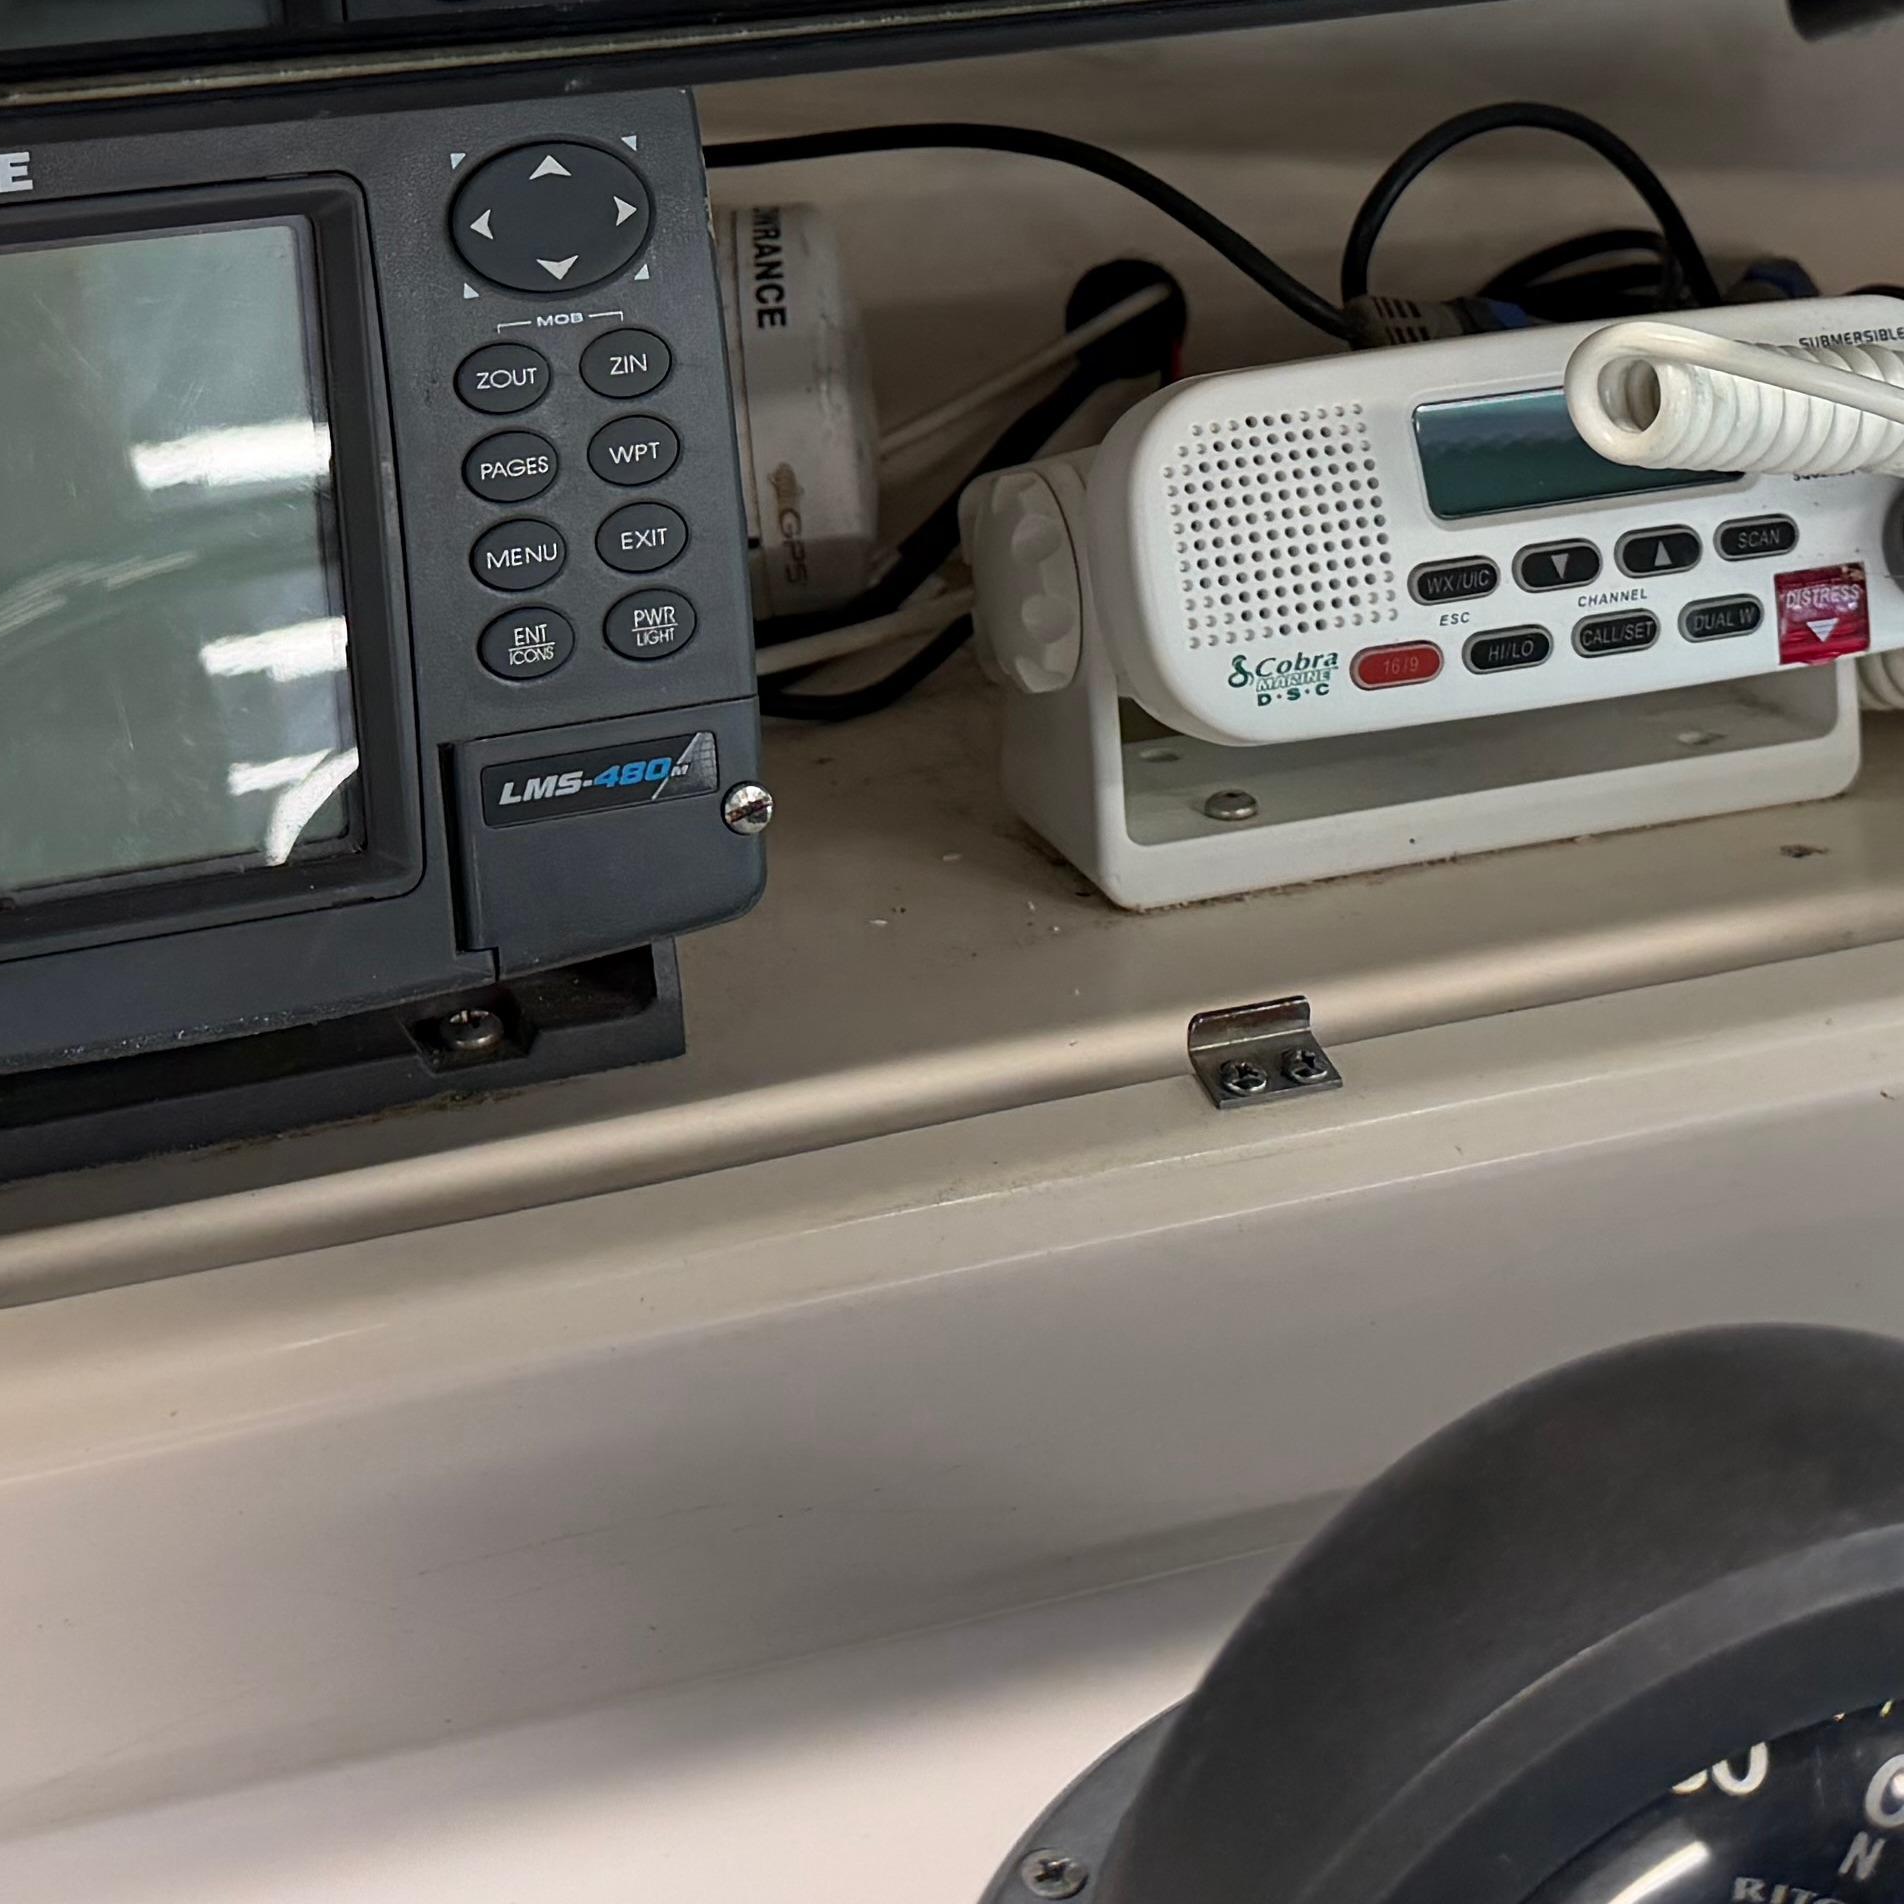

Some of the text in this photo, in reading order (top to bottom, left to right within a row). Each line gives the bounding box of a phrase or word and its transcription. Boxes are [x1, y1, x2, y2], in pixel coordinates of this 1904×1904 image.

[536, 312, 585, 327] MOB
[609, 353, 648, 376] ZIN
[476, 367, 537, 390] ZOUT
[609, 441, 661, 465] WPT
[480, 455, 549, 480] PAGES
[621, 527, 668, 550] EXIT
[1737, 528, 1780, 549] SCAN
[486, 543, 558, 570] MENU
[1578, 589, 1648, 607] CHANNEL
[1786, 584, 1861, 609] DISTRESS
[633, 606, 676, 628] PWR
[1439, 611, 1471, 627] ESC
[1696, 610, 1735, 632] DUAL
[514, 624, 547, 646] ENT
[636, 628, 675, 646] LIGHT
[1582, 620, 1654, 646] CALL/SET
[508, 647, 554, 665] ICONS
[1488, 639, 1535, 662] HI/LO
[1255, 652, 1339, 678] Cobra
[1383, 656, 1420, 676] 16/9
[1256, 669, 1333, 693] MARINE
